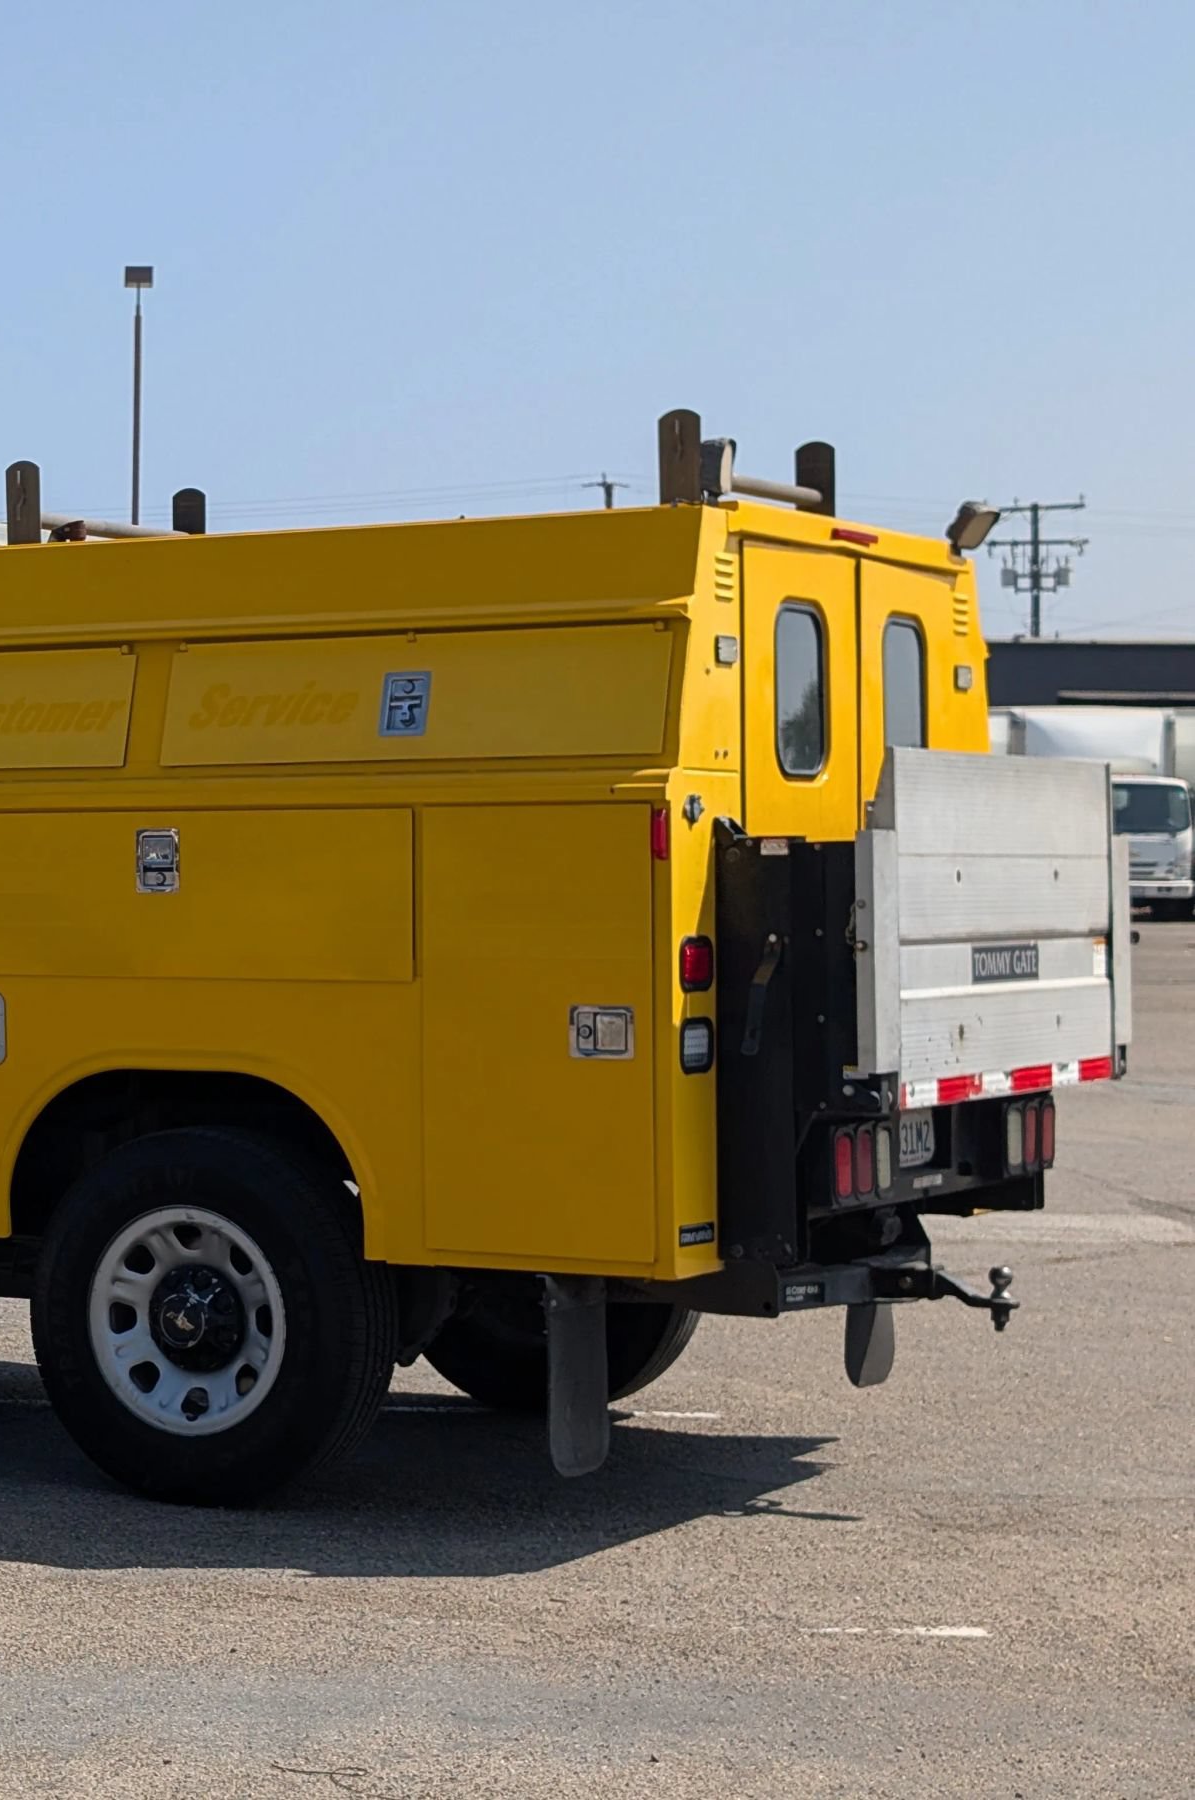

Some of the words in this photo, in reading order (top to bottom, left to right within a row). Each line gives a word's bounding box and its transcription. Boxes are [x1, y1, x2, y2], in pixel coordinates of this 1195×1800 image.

[188, 680, 359, 731] Service
[974, 951, 1011, 976] TOMMY
[1013, 949, 1037, 974] GATE
